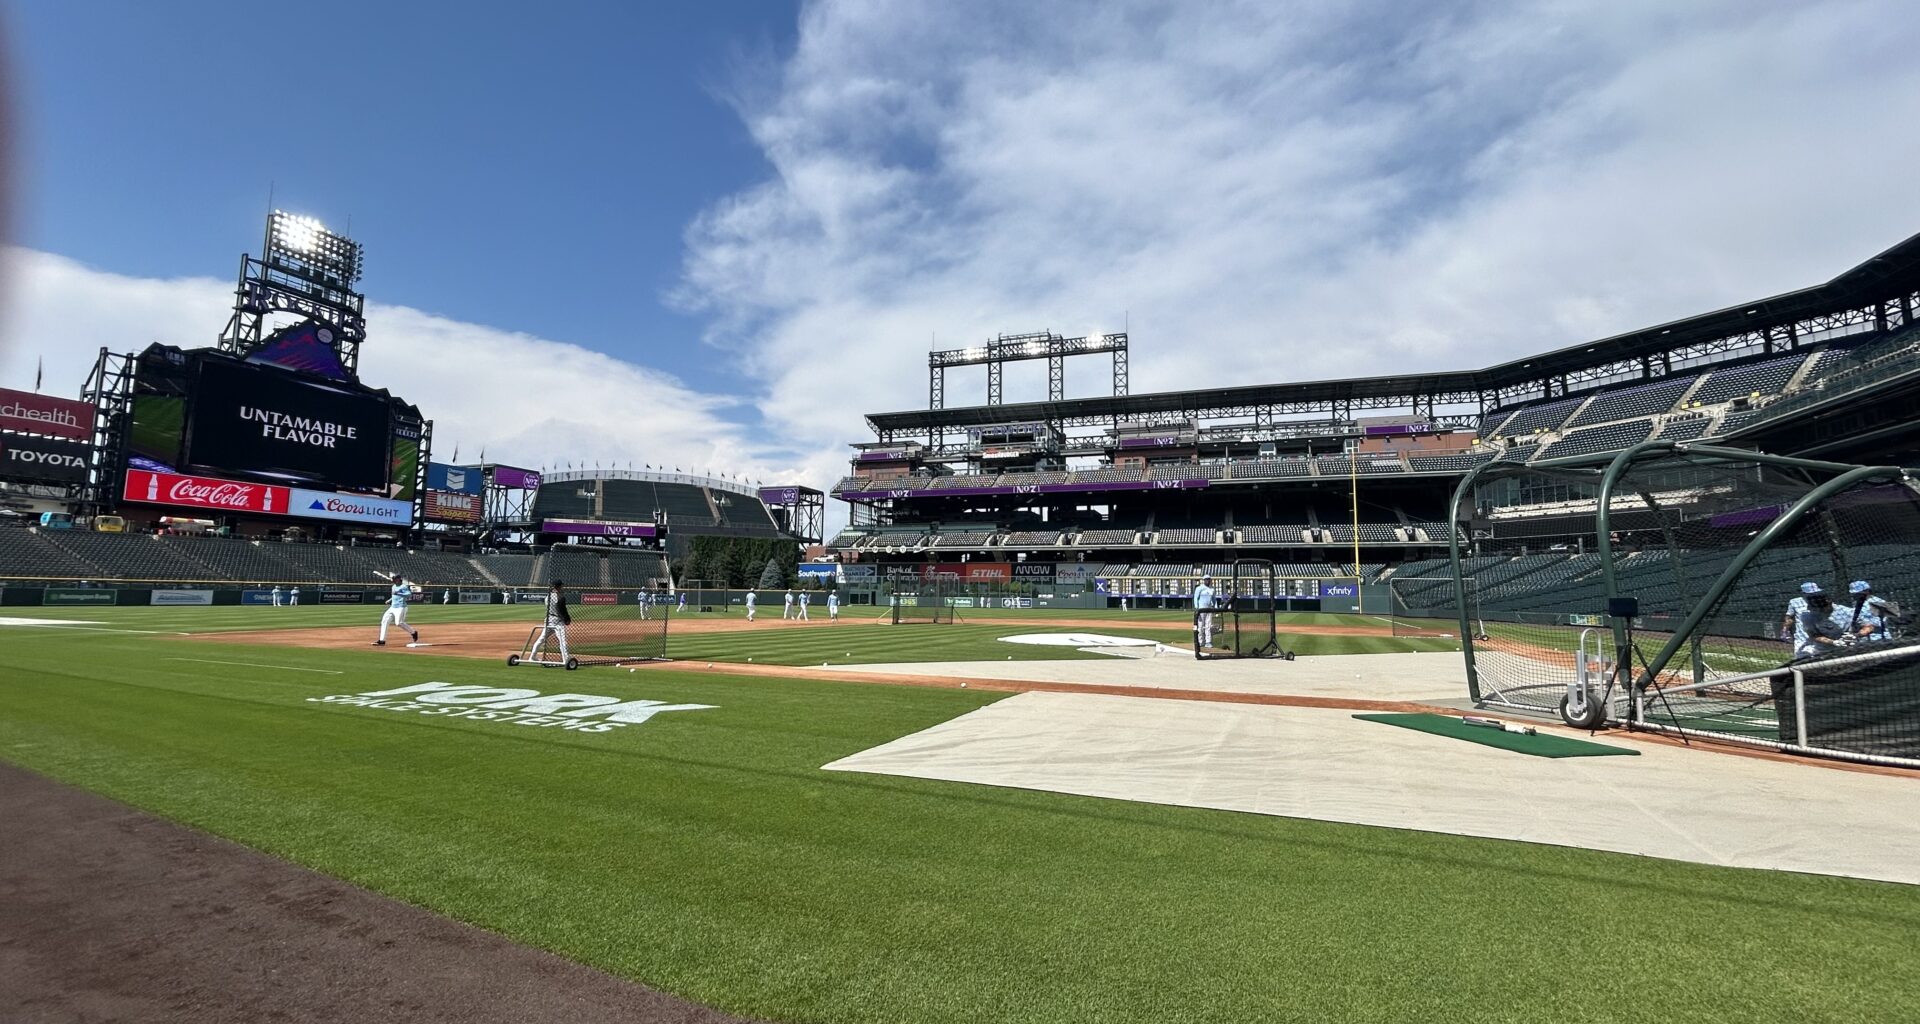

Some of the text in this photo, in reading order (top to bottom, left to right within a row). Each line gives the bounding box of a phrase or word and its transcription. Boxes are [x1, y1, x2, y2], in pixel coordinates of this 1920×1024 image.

[243, 282, 367, 342] ROCKIES
[0, 402, 77, 427] chealth
[240, 406, 357, 440] UNTAMABLE
[263, 424, 335, 449] FLAVOR
[8, 449, 86, 469] TOYOTA
[169, 479, 253, 507] Coca-Cola
[436, 494, 472, 510] KING
[327, 499, 400, 518] Coors LIGHT
[797, 570, 833, 578] Southwest
[972, 569, 1005, 578] STIHL
[1327, 585, 1352, 596] xfinity
[357, 681, 720, 724] YORK
[419, 704, 627, 733] SYSTEMS
